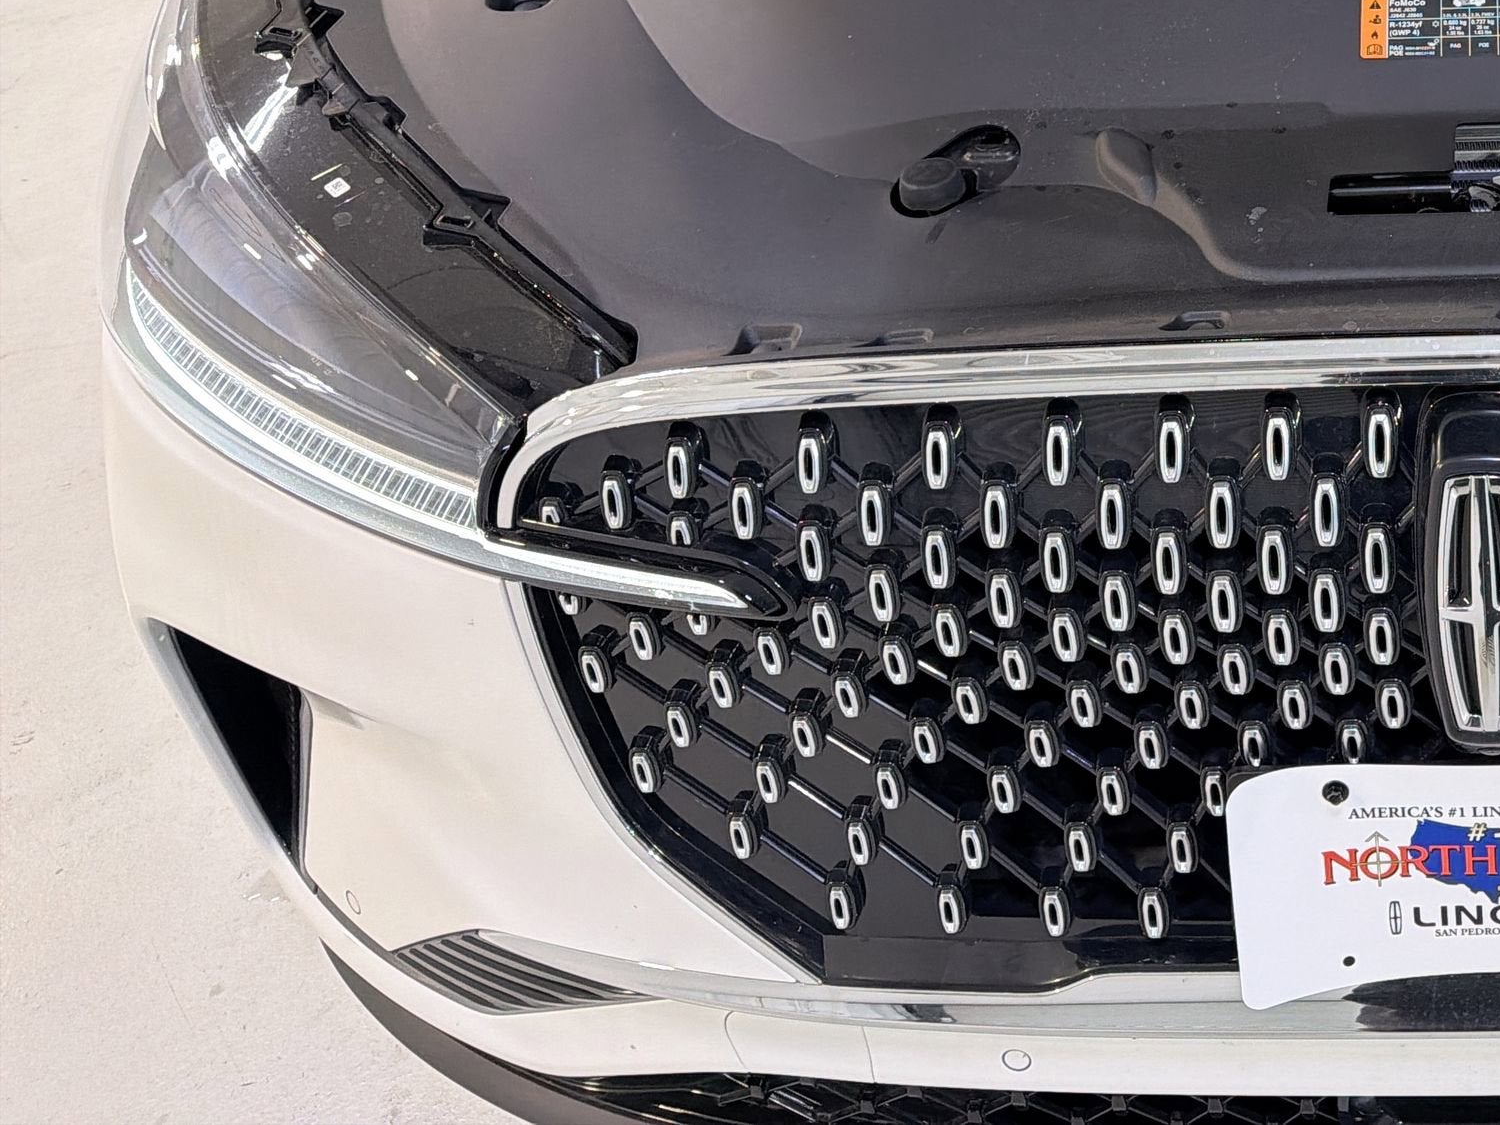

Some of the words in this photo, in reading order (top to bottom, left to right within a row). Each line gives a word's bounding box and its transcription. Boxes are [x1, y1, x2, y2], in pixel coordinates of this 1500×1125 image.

[1349, 806, 1444, 819] AMERICA'S
[1448, 807, 1466, 818] #1
[1321, 844, 1499, 886] NORTH
[1435, 928, 1458, 937] SAN
